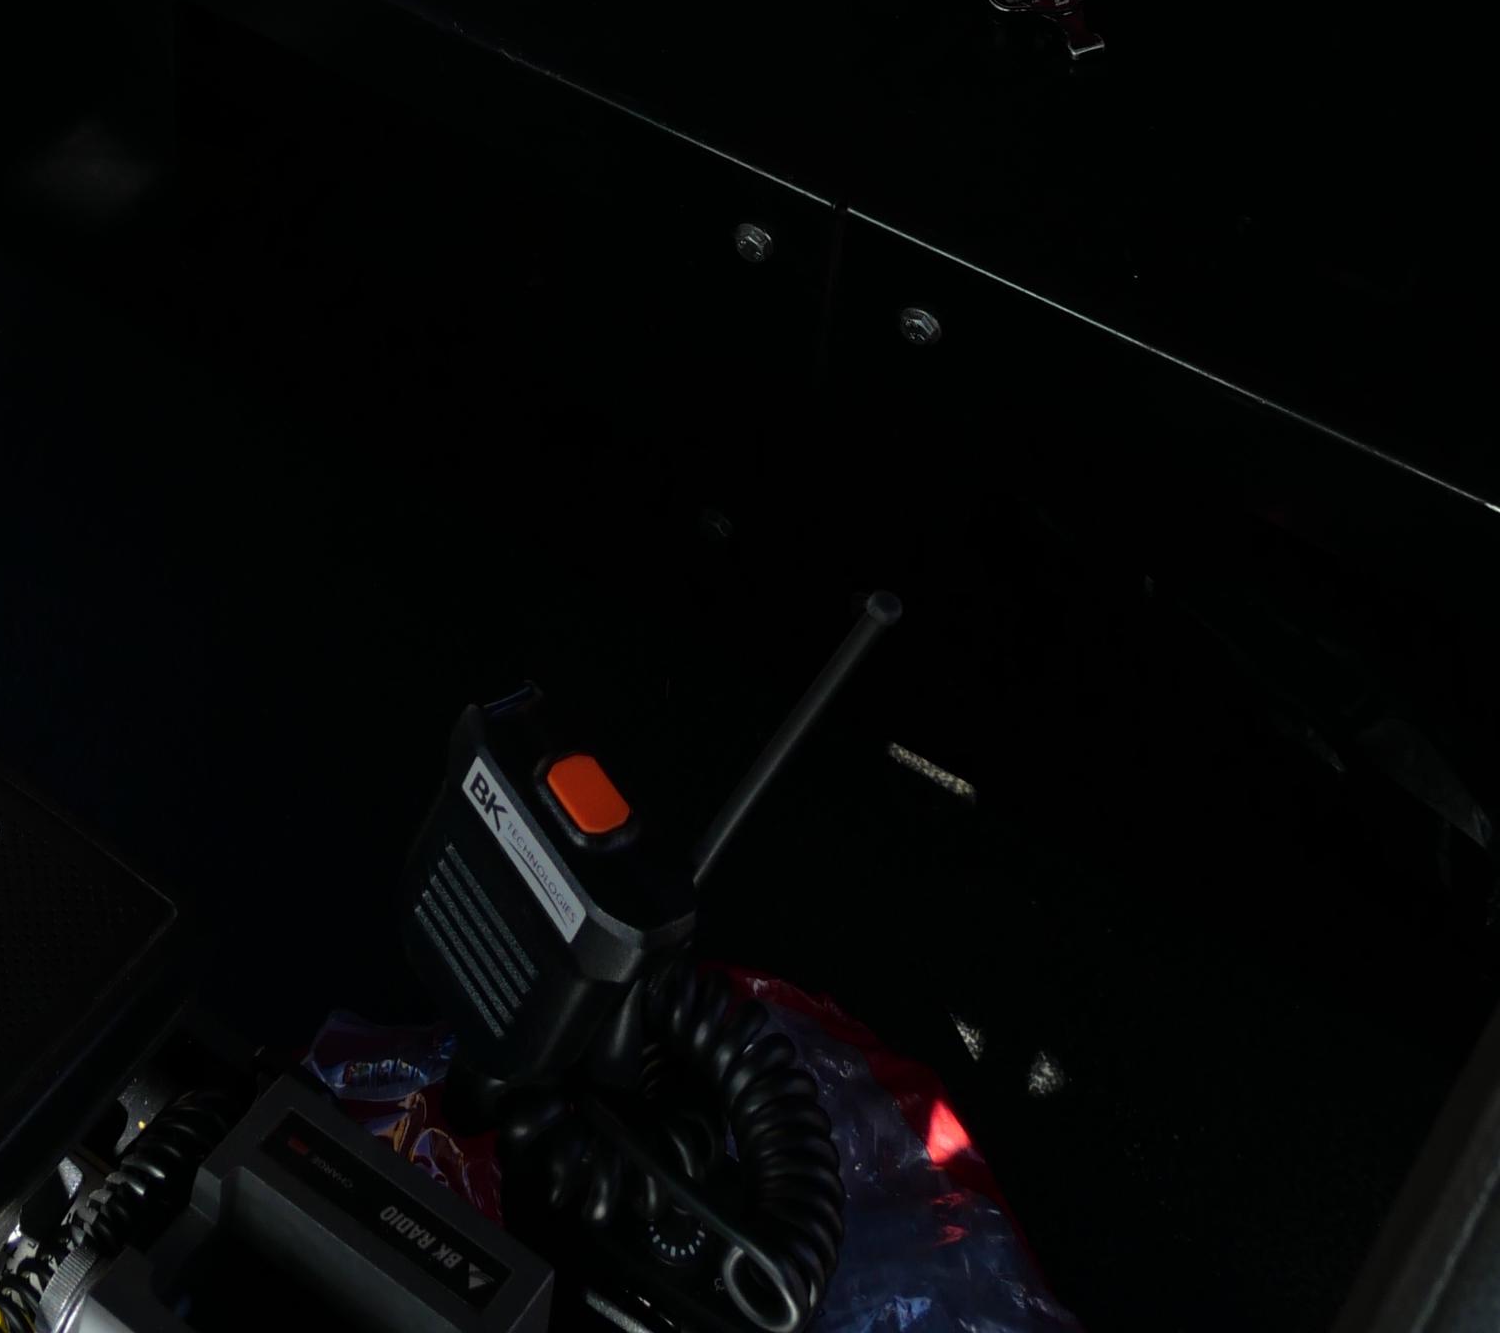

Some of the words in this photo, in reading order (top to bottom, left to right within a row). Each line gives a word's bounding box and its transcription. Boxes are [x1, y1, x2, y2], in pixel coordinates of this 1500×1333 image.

[469, 771, 508, 832] BK
[507, 820, 578, 924] TECHNOLOGIES
[379, 1205, 436, 1250] RADIO
[432, 1241, 464, 1269] BK
